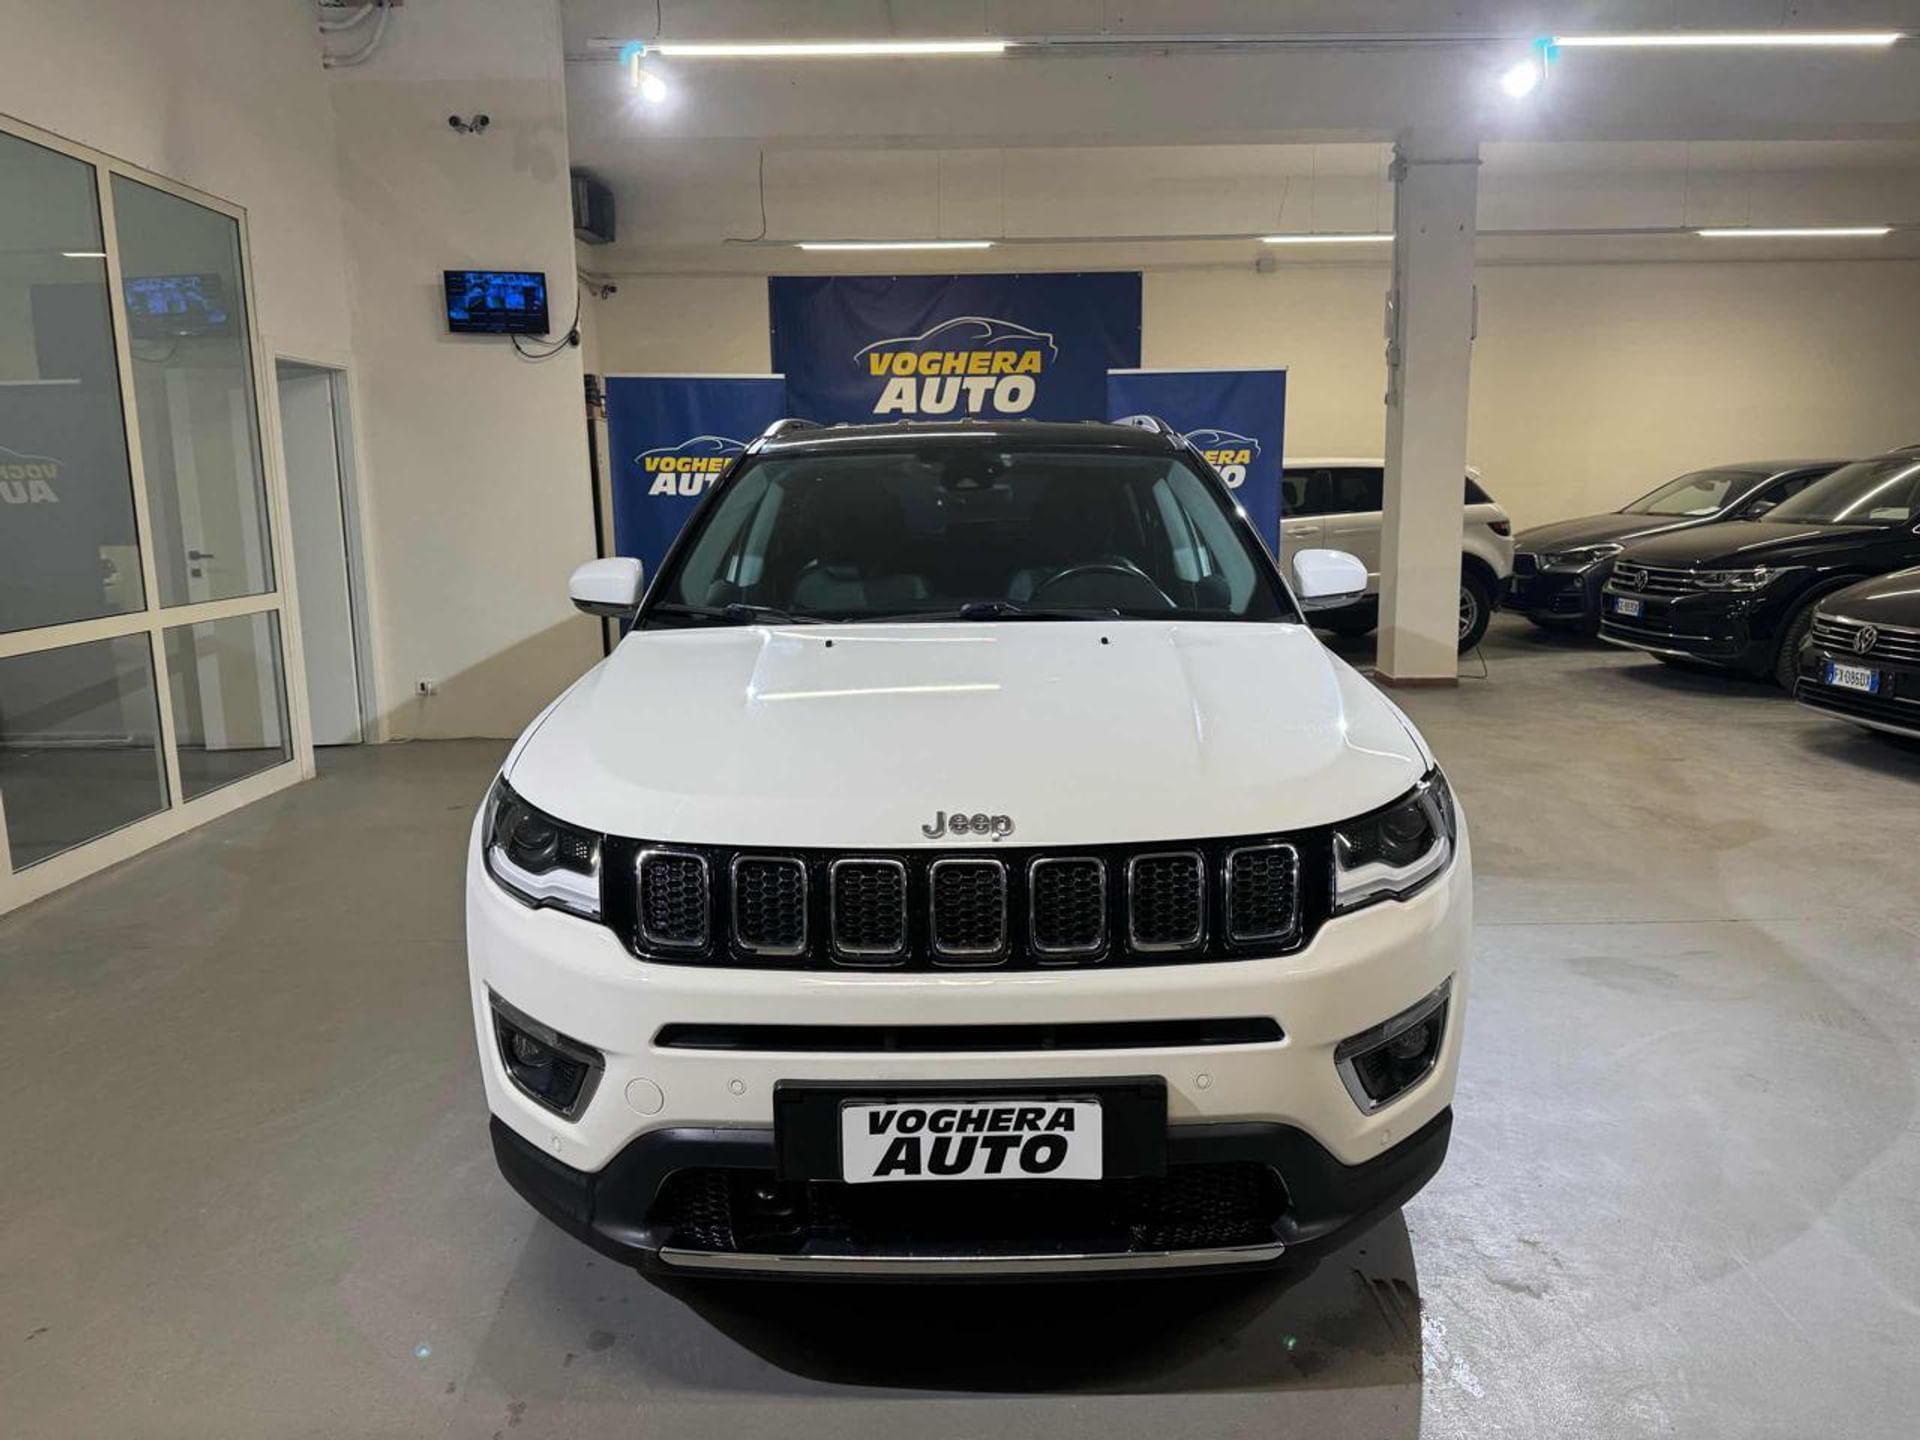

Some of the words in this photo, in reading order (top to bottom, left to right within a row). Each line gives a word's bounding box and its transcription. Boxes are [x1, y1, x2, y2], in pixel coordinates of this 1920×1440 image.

[869, 350, 1041, 376] VOGHERA
[873, 375, 1036, 414] AUTO
[922, 810, 1017, 842] Jeep
[869, 1107, 1075, 1135] VOGHERA
[872, 1133, 1068, 1177] AUTO
